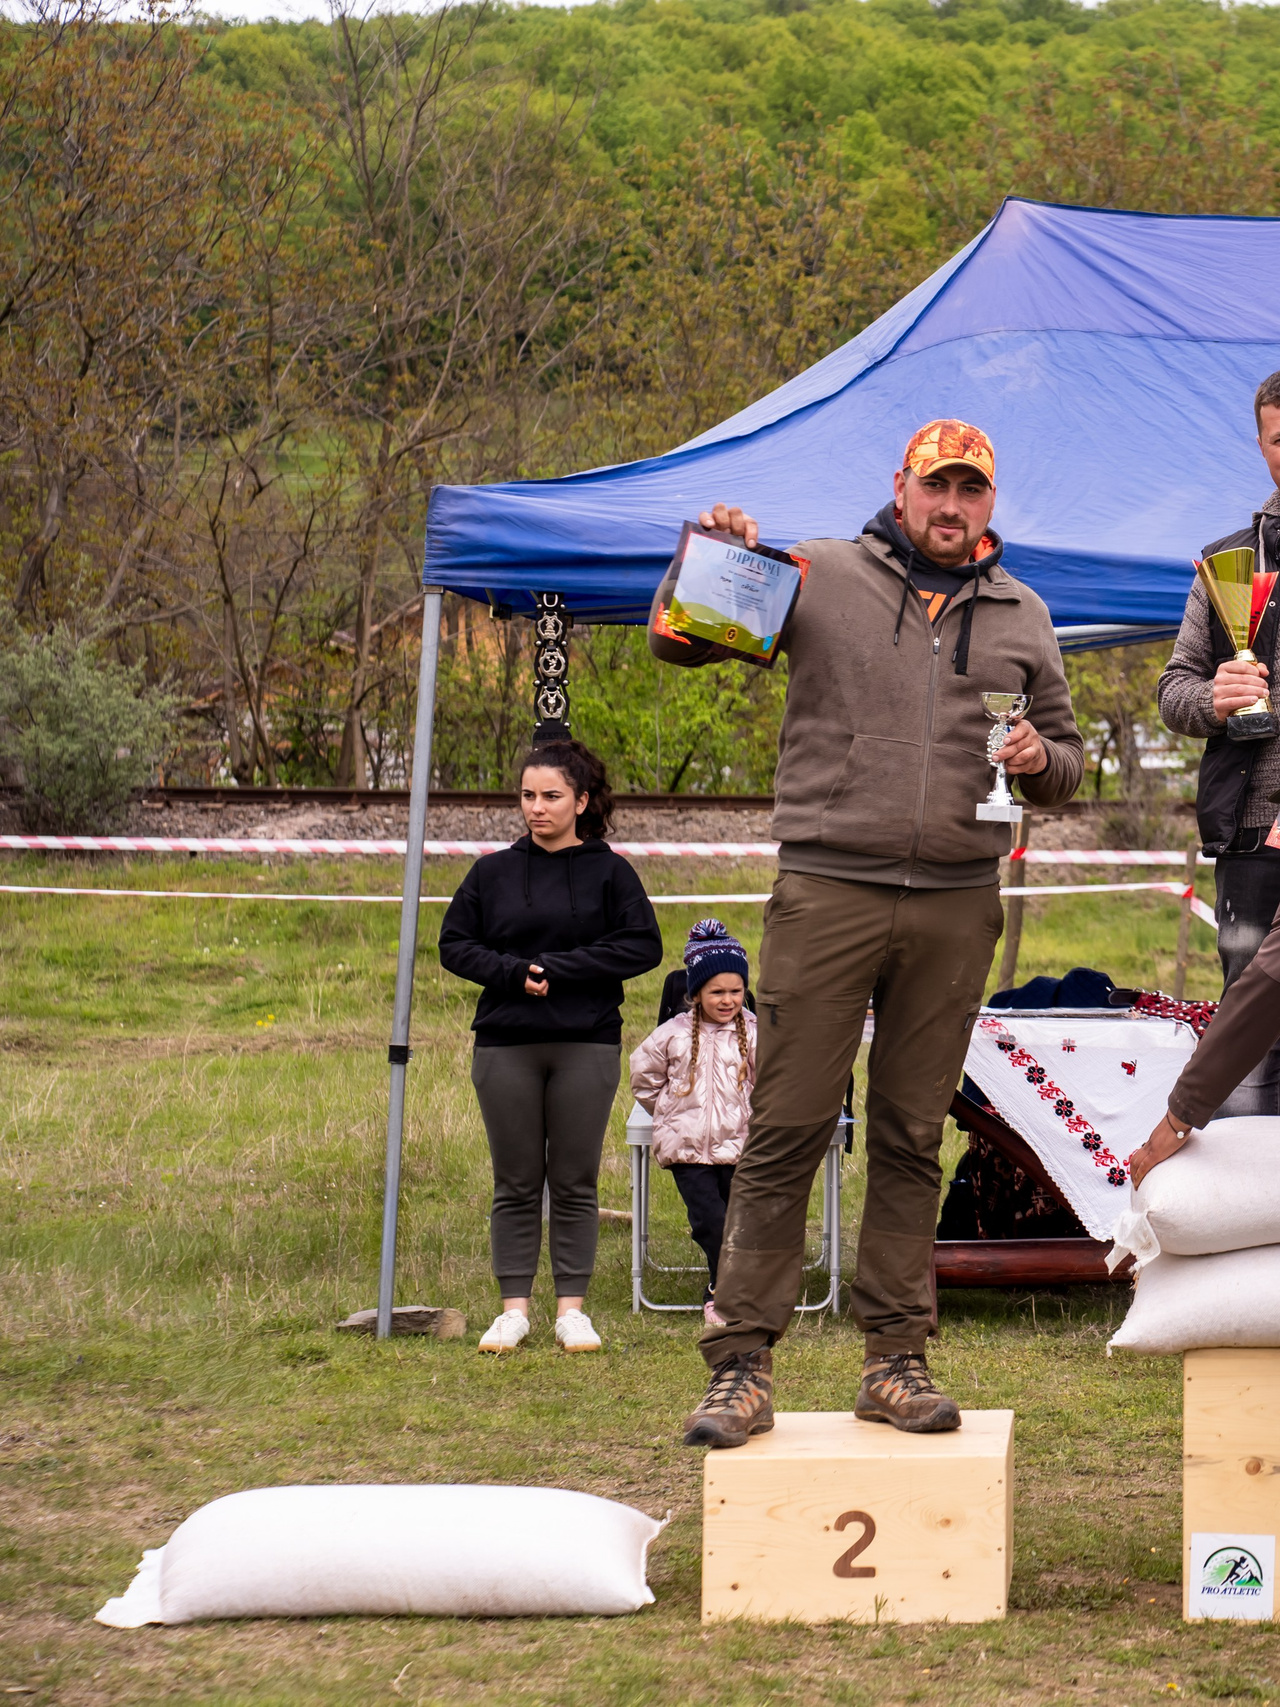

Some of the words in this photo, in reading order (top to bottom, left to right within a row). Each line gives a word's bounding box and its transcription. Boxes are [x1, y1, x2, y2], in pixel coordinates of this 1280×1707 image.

[725, 548, 781, 577] DIPLOMĂ
[832, 1510, 876, 1578] 2
[1201, 1586, 1220, 1595] PRO
[1220, 1587, 1262, 1596] ATLETIC
